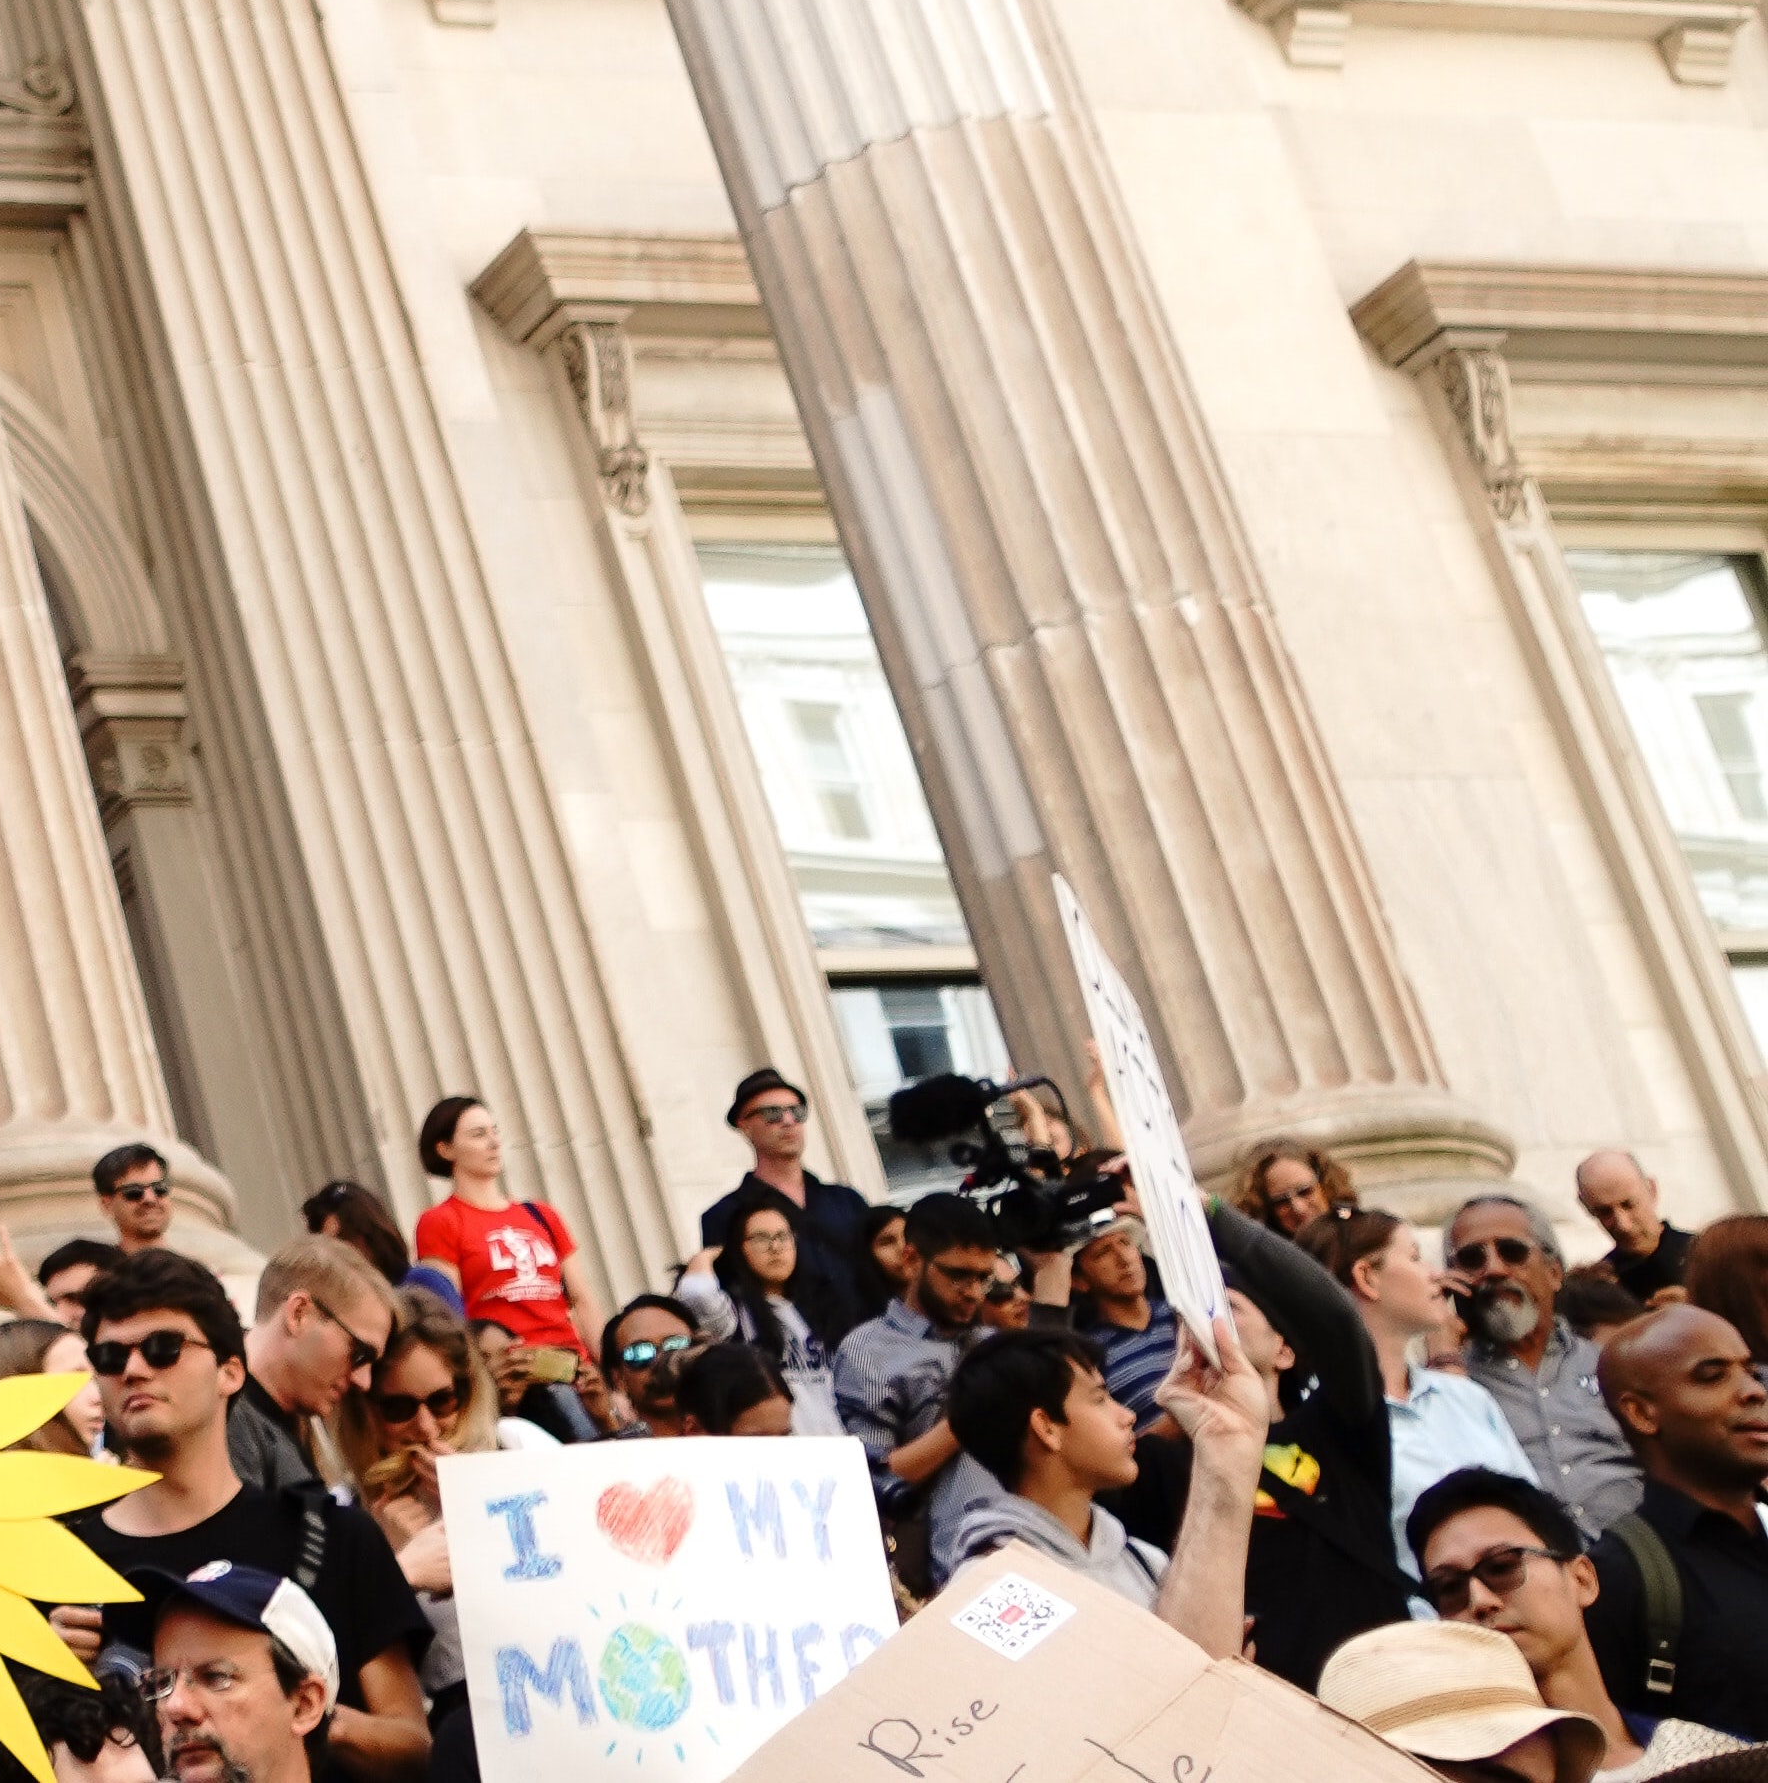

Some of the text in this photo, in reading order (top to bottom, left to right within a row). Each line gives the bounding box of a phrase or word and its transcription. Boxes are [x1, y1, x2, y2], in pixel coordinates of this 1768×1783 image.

[485, 1474, 838, 1582] I MY
[858, 1697, 1000, 1778] Rise
